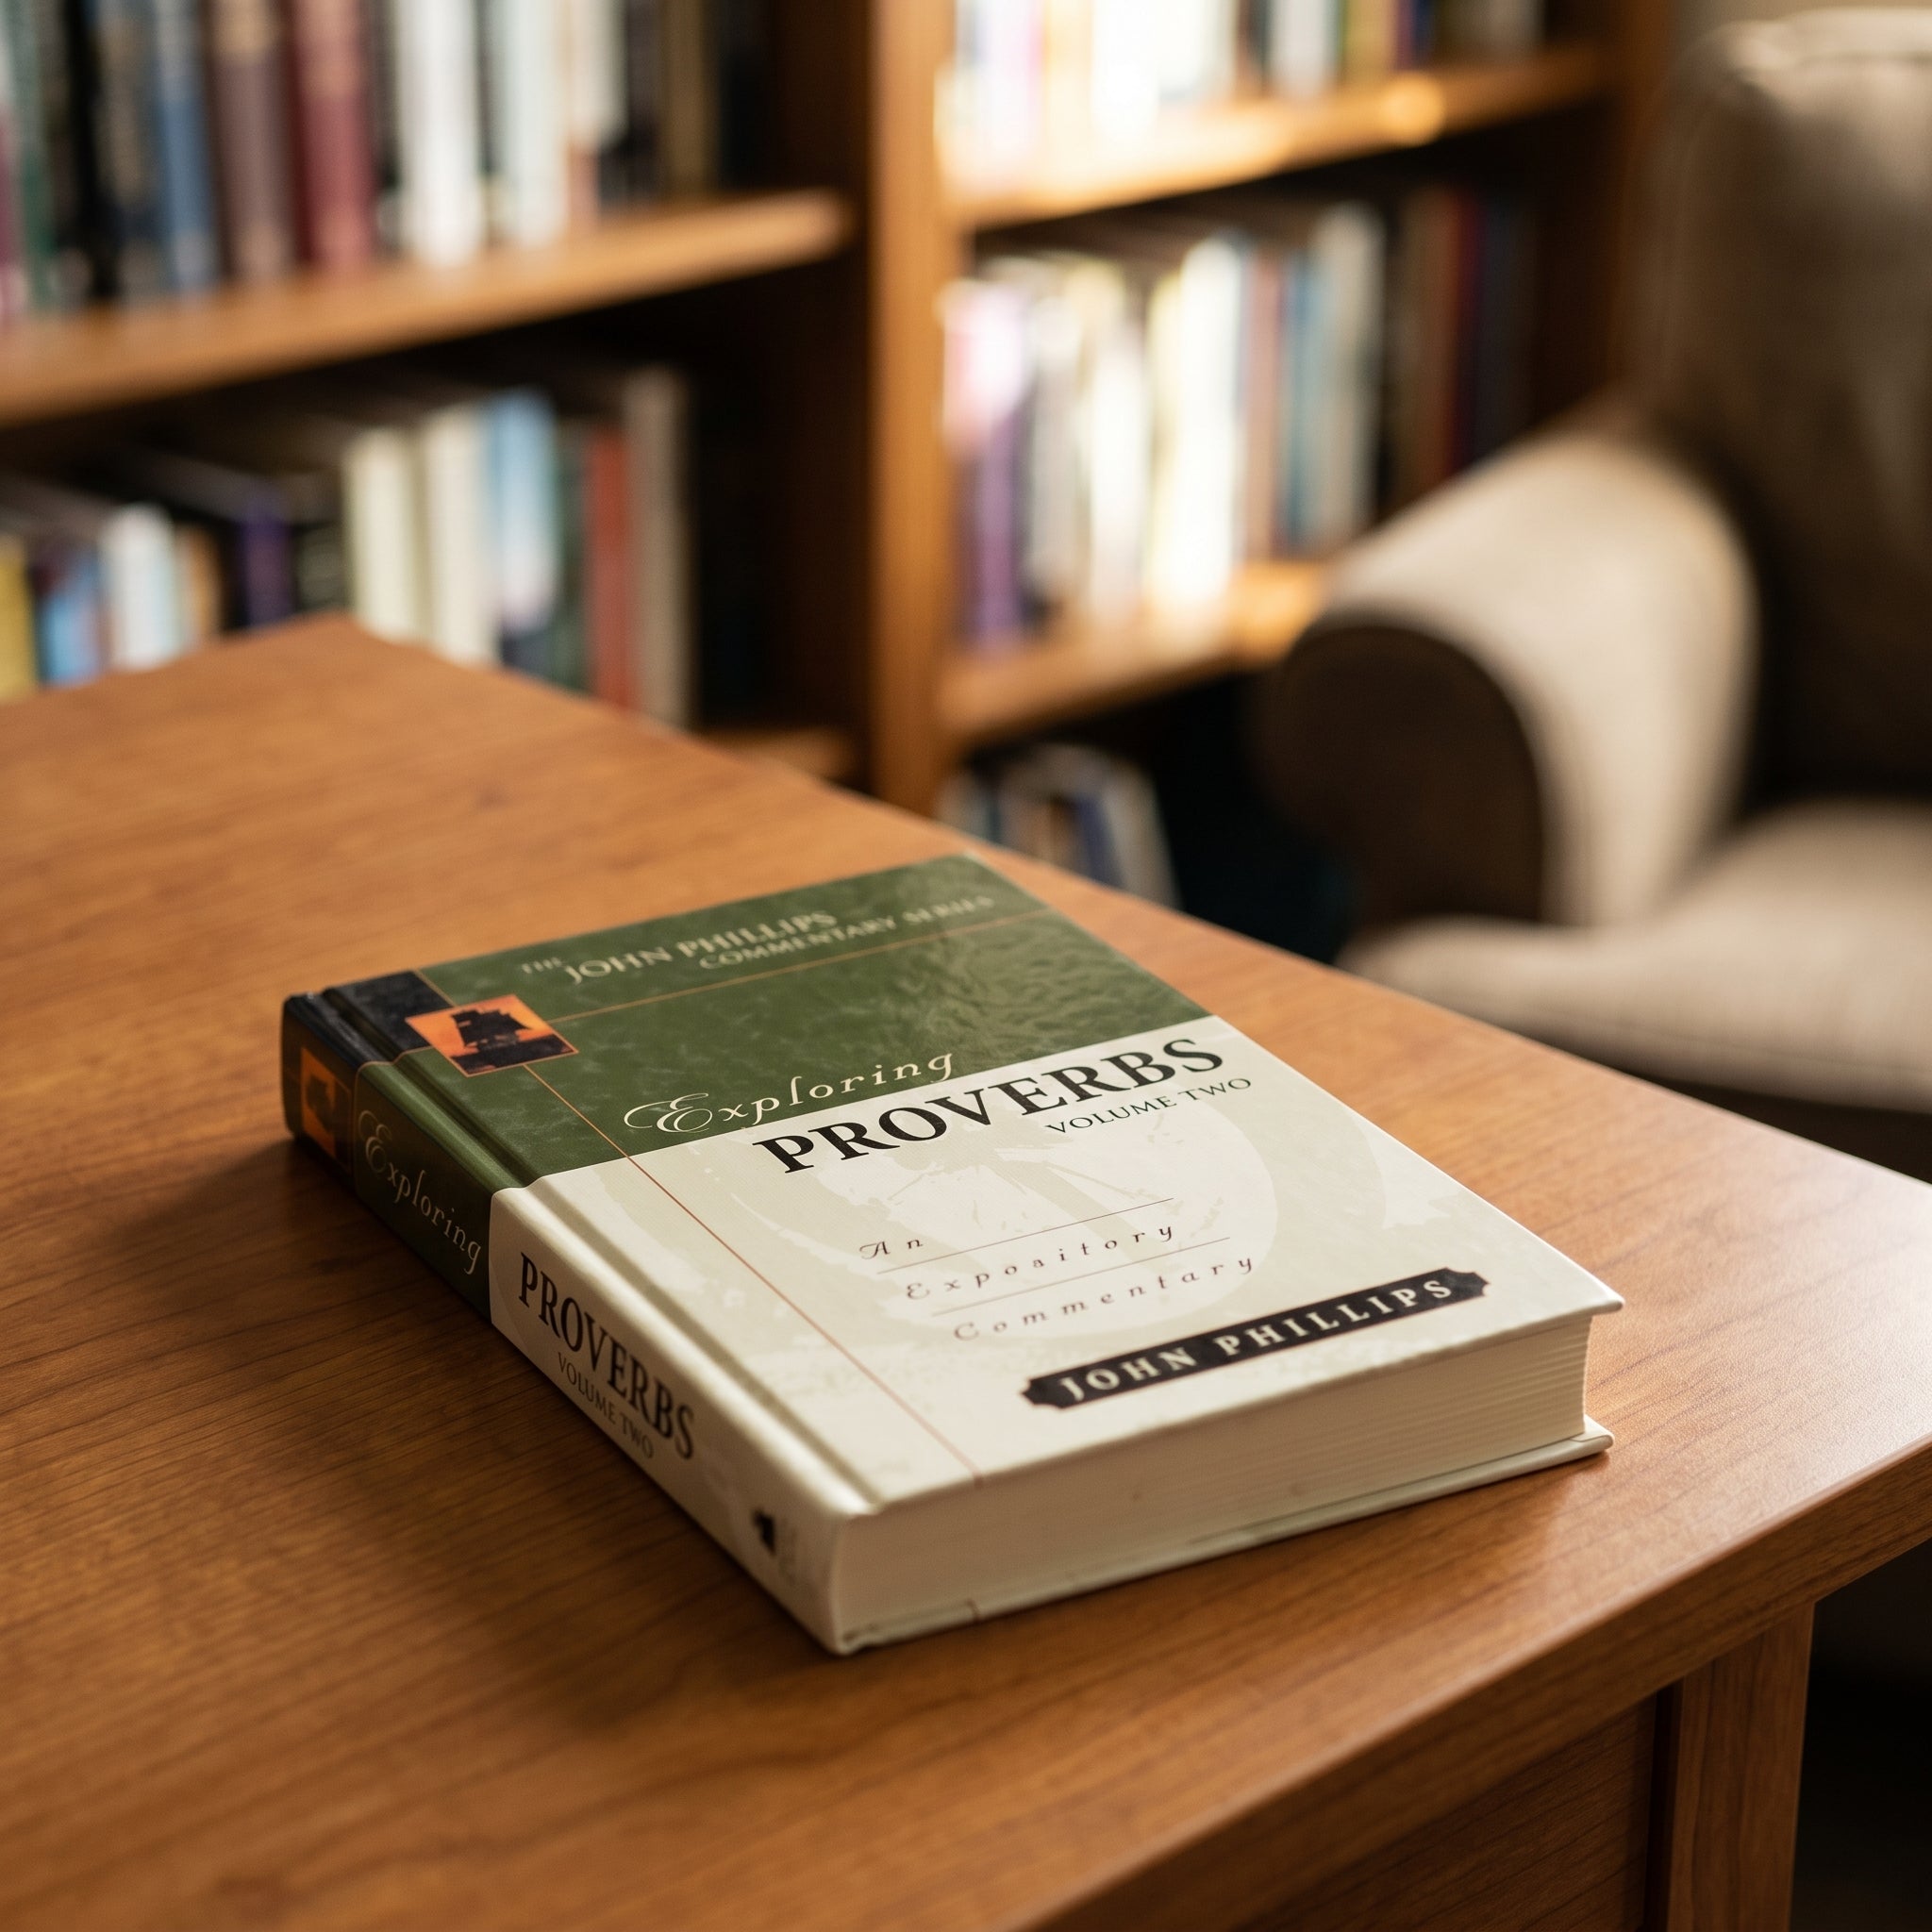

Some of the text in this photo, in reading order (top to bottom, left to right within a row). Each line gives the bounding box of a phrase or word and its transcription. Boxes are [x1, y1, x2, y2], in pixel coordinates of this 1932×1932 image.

[564, 946, 674, 984] JOHN
[676, 910, 838, 958] PHILLIPS
[698, 916, 896, 971] COMMENTARY
[624, 1052, 954, 1133] Exploring
[752, 1038, 1224, 1174] PROVERBS
[1044, 1077, 1252, 1134] VOLUME TWO
[358, 1109, 481, 1274] Exploring
[859, 1238, 924, 1260] An
[954, 1257, 1253, 1341] Commentary
[1059, 1277, 1453, 1402] JOHN PHILLIPS
[518, 1252, 695, 1460] PROVERBS
[558, 1352, 655, 1460] VOLUME TWO
